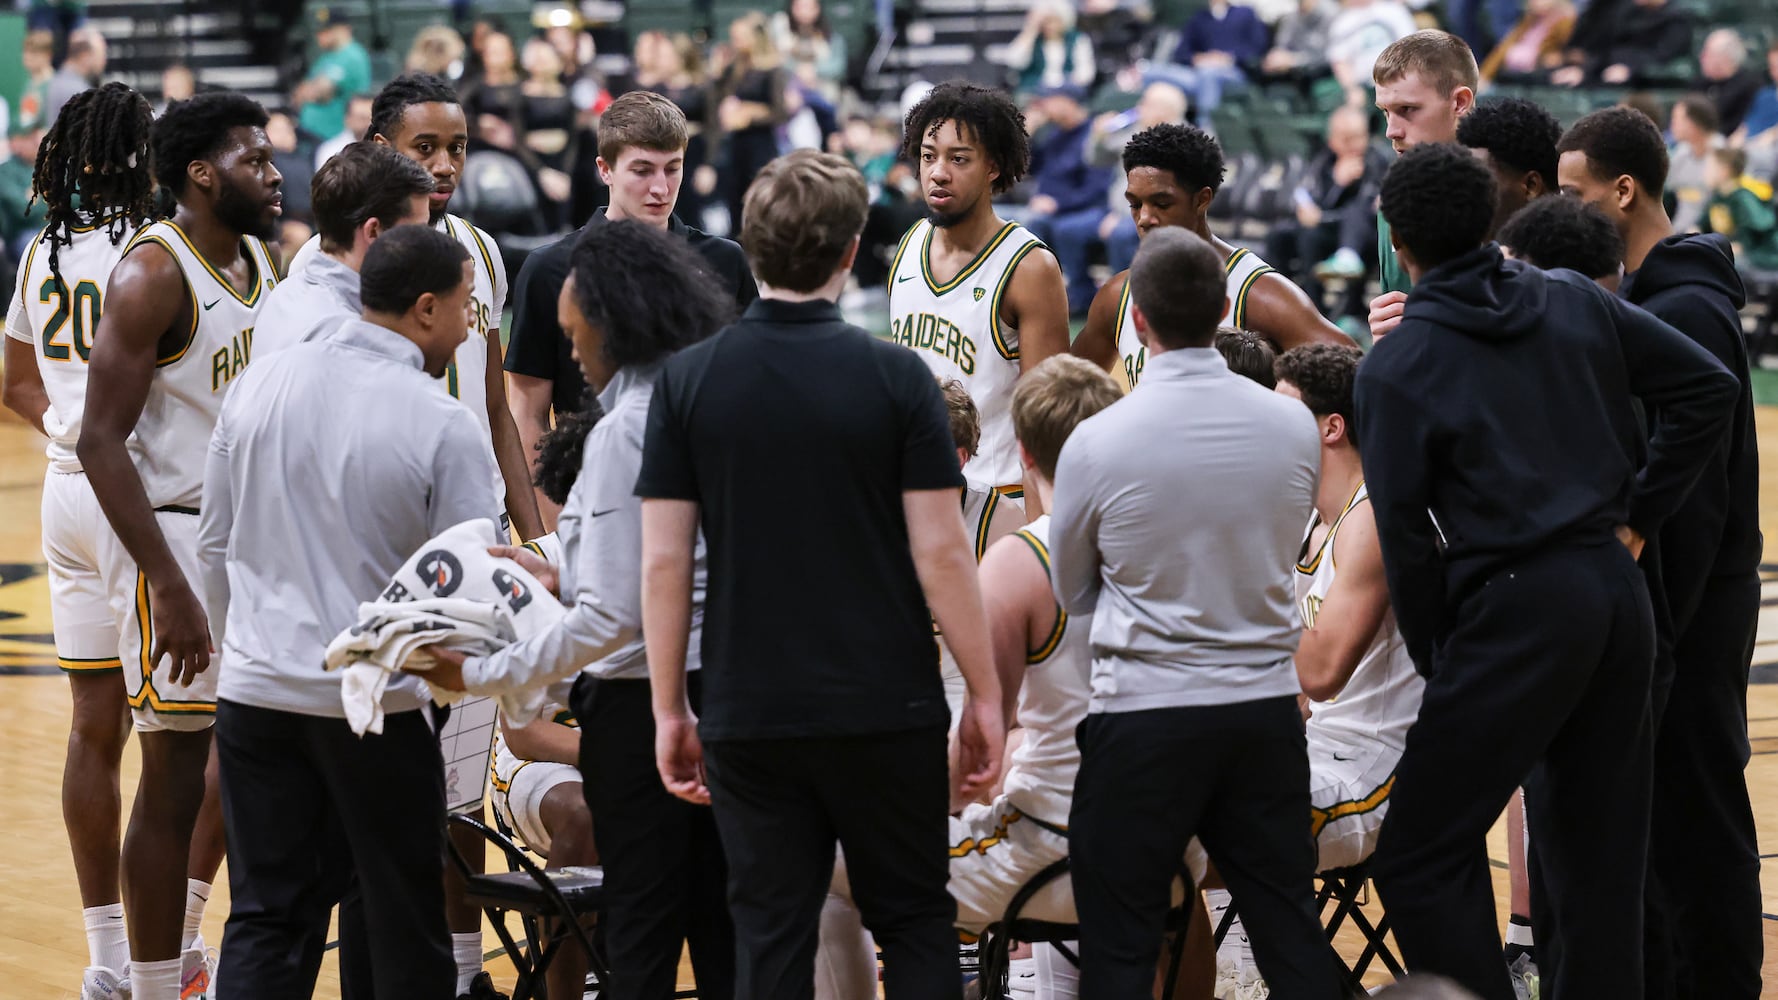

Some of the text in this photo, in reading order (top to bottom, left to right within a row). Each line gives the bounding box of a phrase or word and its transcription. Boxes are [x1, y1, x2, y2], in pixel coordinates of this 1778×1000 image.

[39, 275, 103, 364] 20
[893, 312, 977, 377] RAIDERS
[211, 325, 255, 394] RAI
